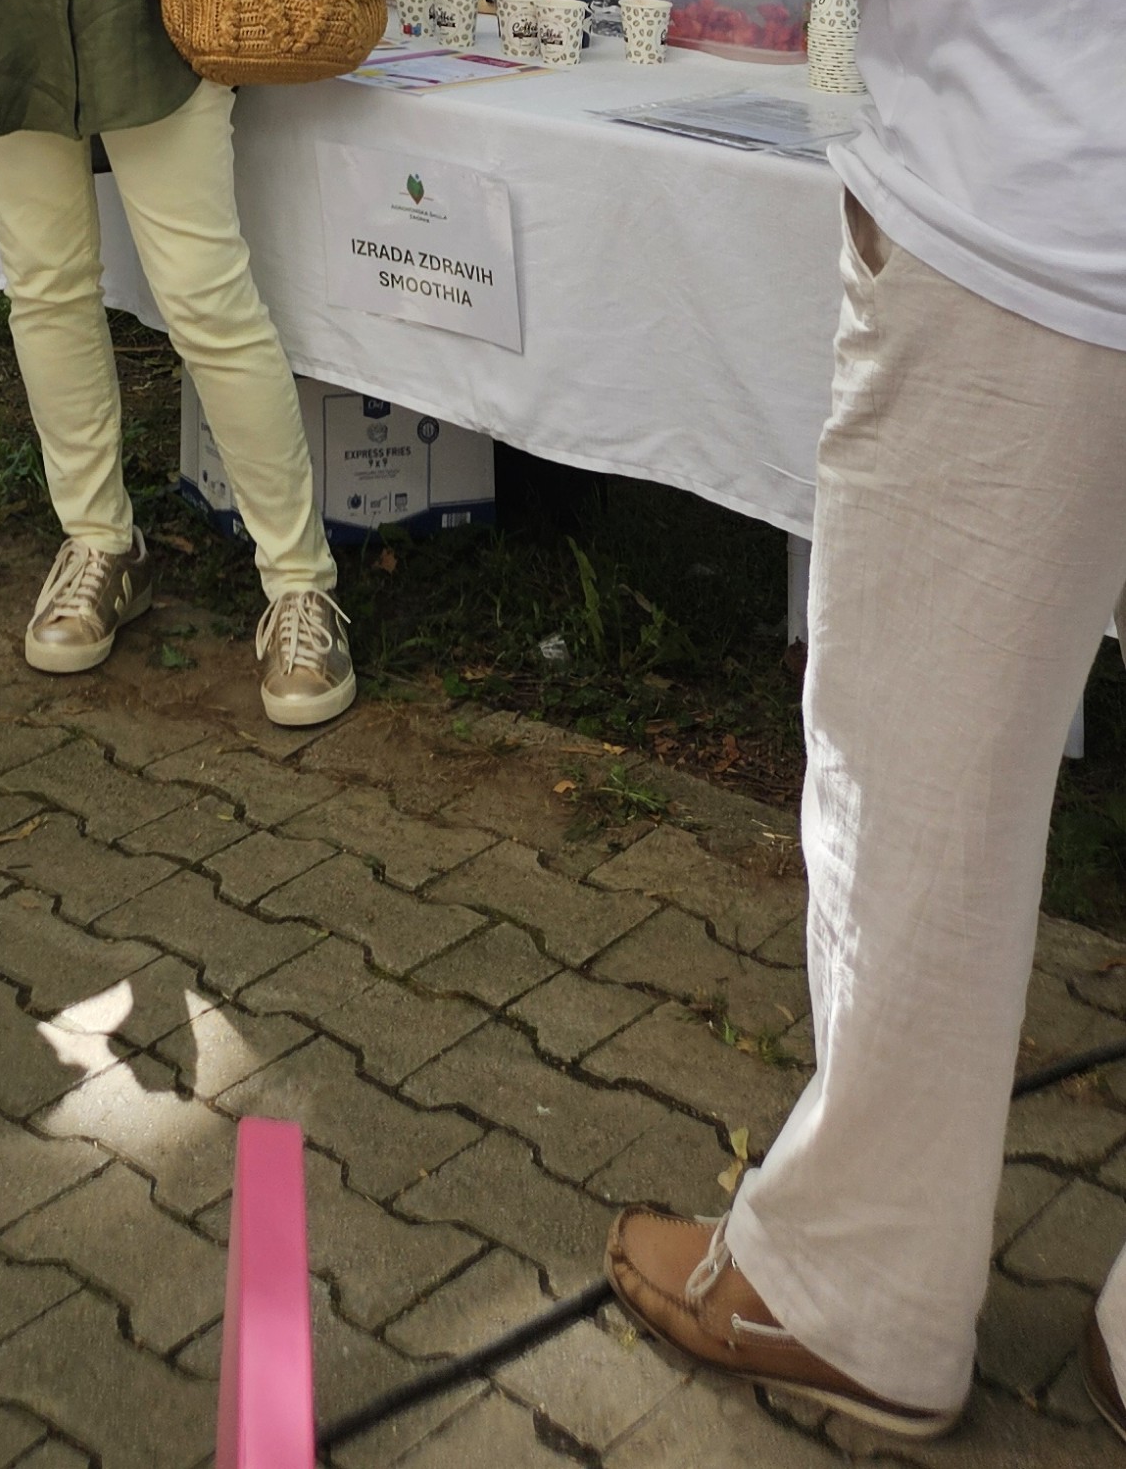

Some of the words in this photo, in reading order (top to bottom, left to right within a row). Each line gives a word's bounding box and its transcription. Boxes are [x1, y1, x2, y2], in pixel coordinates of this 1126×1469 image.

[351, 238, 415, 267] IZRADA
[418, 251, 494, 286] ZDRAVIH
[379, 271, 473, 308] SMOOTHIA
[344, 448, 384, 461] EXPRESS
[386, 445, 412, 458] FRIES
